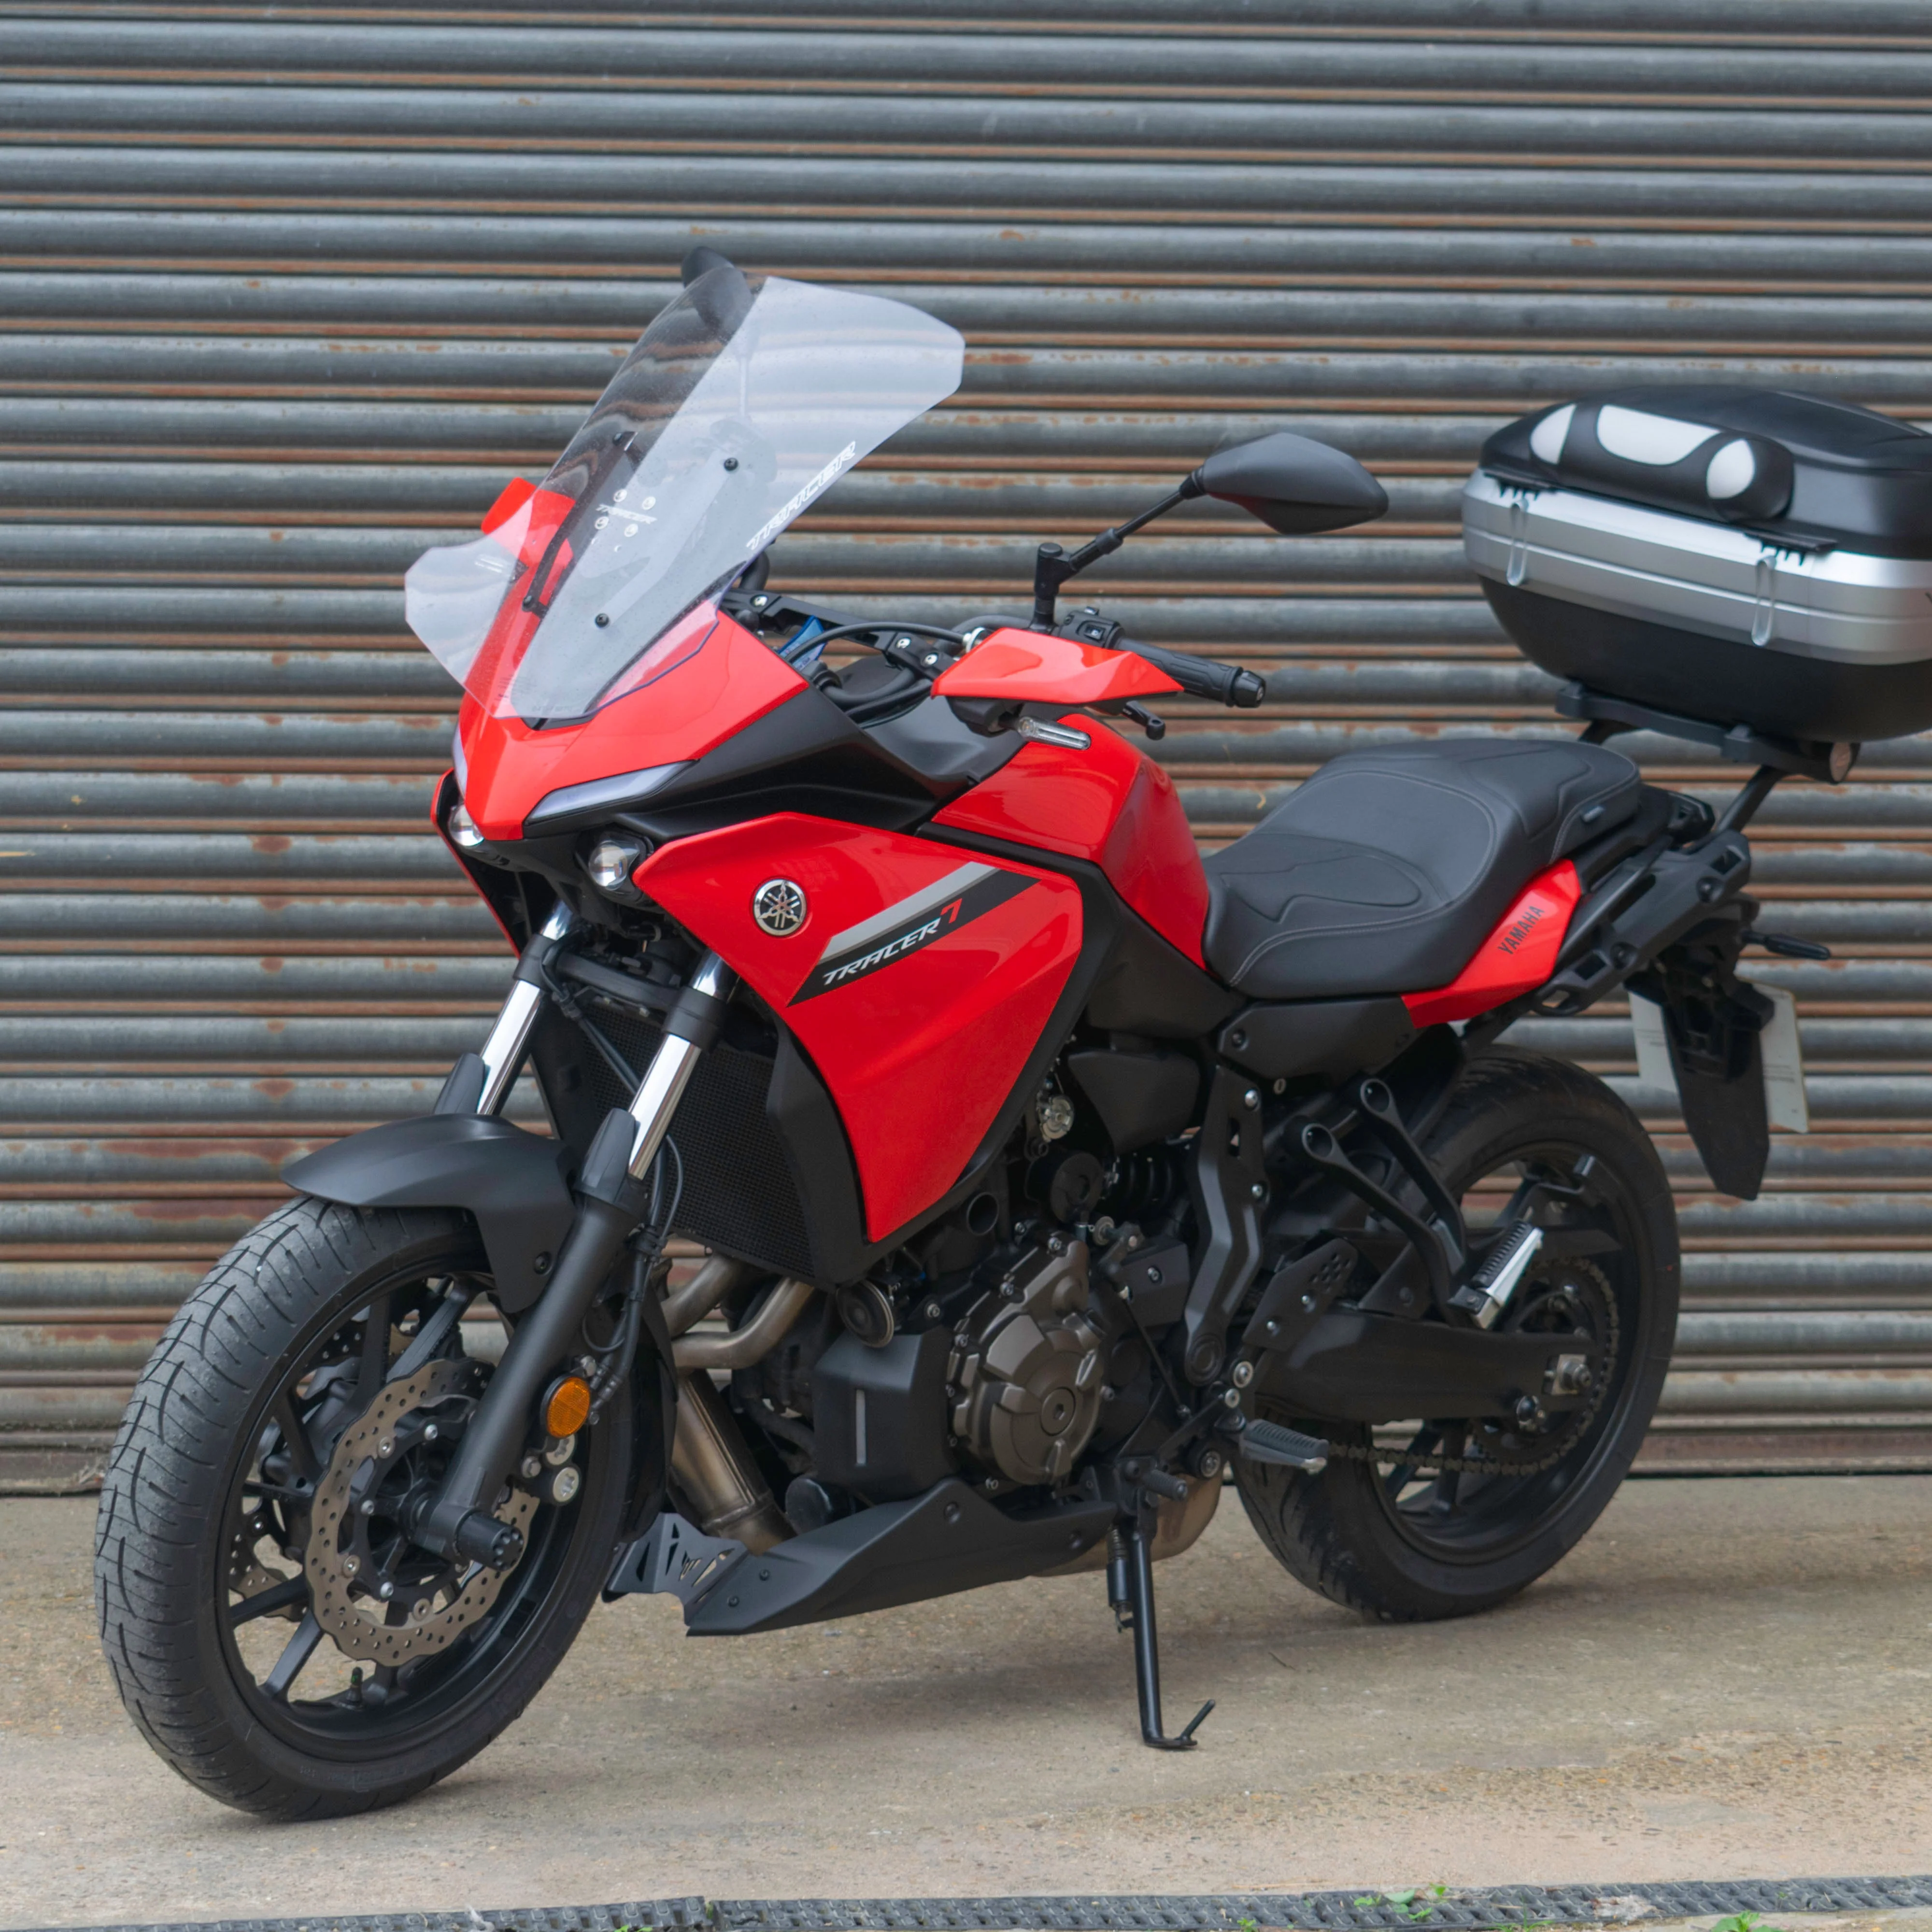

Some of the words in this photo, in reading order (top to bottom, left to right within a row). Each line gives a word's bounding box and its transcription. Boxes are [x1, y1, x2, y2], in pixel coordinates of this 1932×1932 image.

[746, 440, 855, 550] TRACER
[823, 918, 940, 985] TRACER
[941, 898, 962, 923] 7
[1498, 906, 1545, 954] YAMAHA
